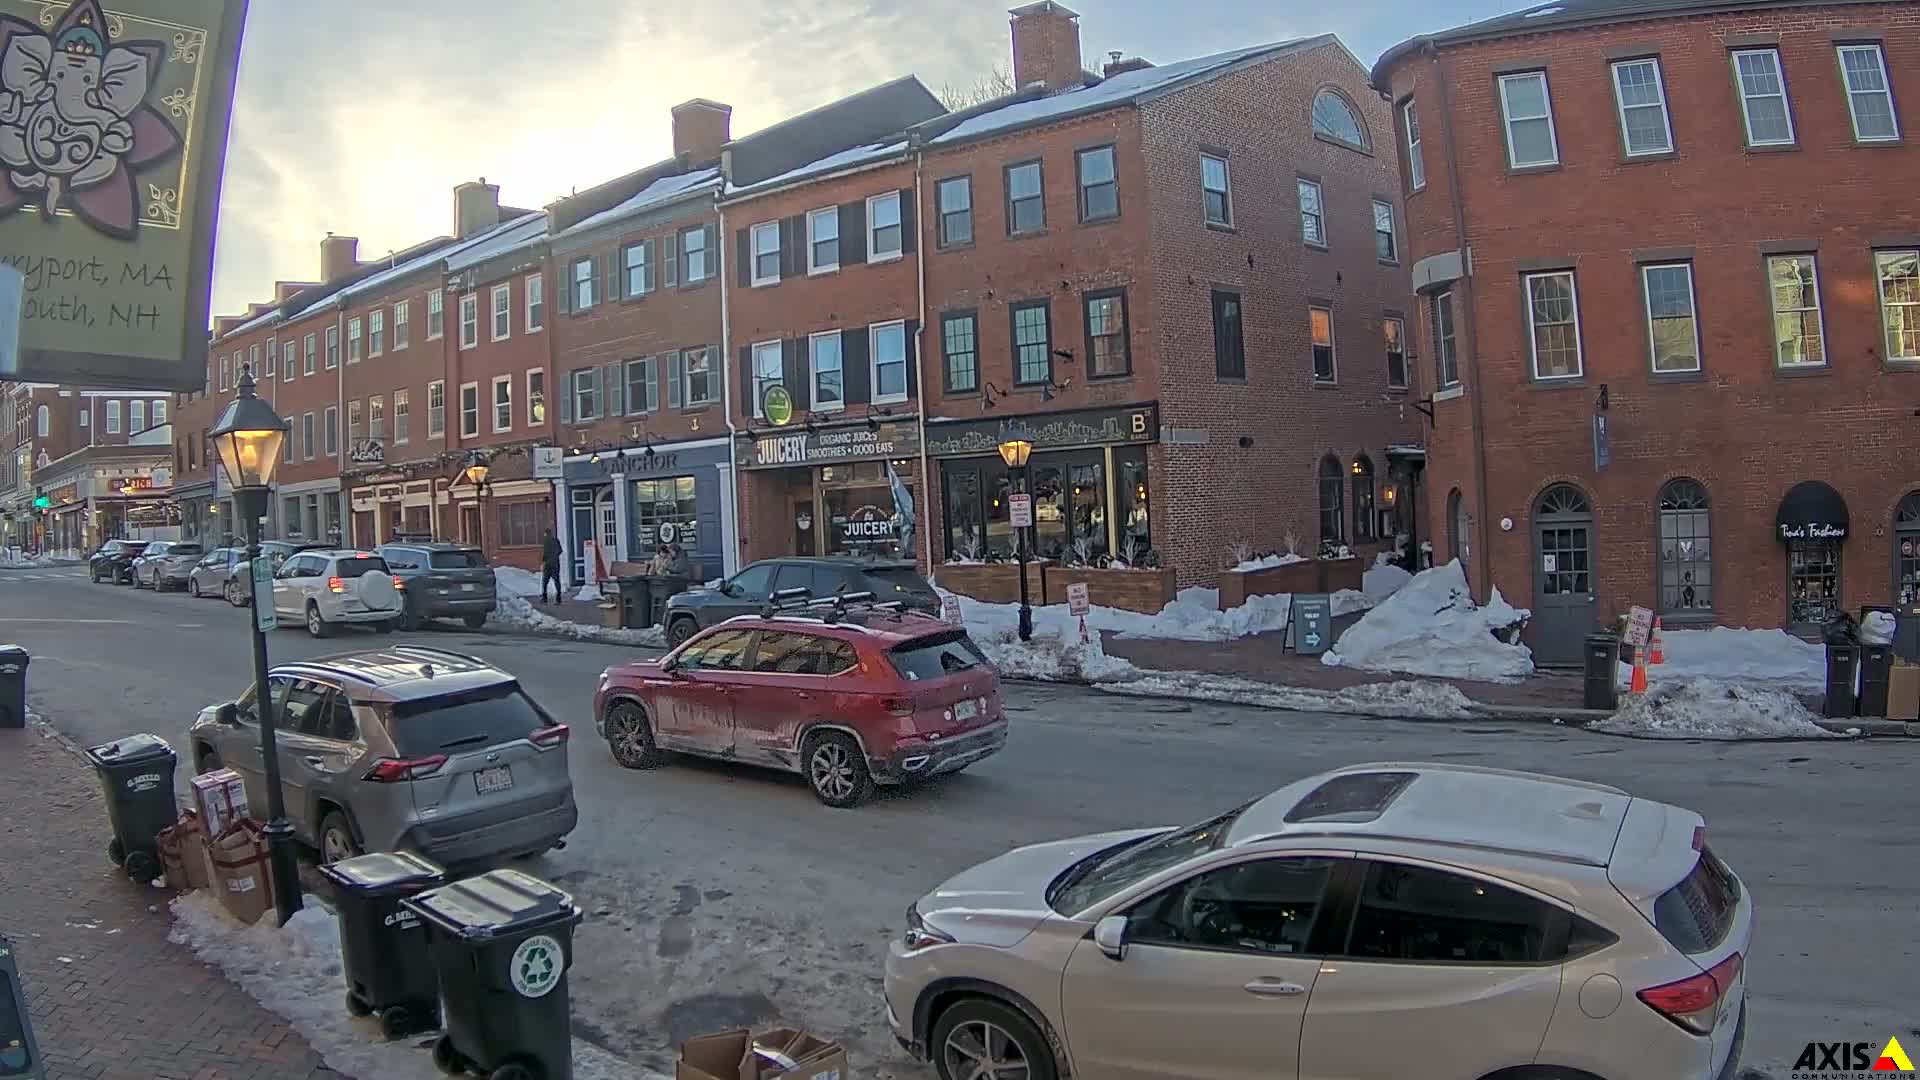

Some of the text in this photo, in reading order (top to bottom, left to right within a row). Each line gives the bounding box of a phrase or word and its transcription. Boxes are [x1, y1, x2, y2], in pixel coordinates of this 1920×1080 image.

[1, 255, 174, 292] ryport, MA
[109, 303, 160, 331] NH
[1132, 414, 1146, 433] B
[819, 431, 878, 446] ORGANIC JUICES
[757, 434, 808, 465] JUICERY
[807, 441, 894, 460] SMOOTHIES GOOD EATS
[843, 521, 894, 537] JUICERY
